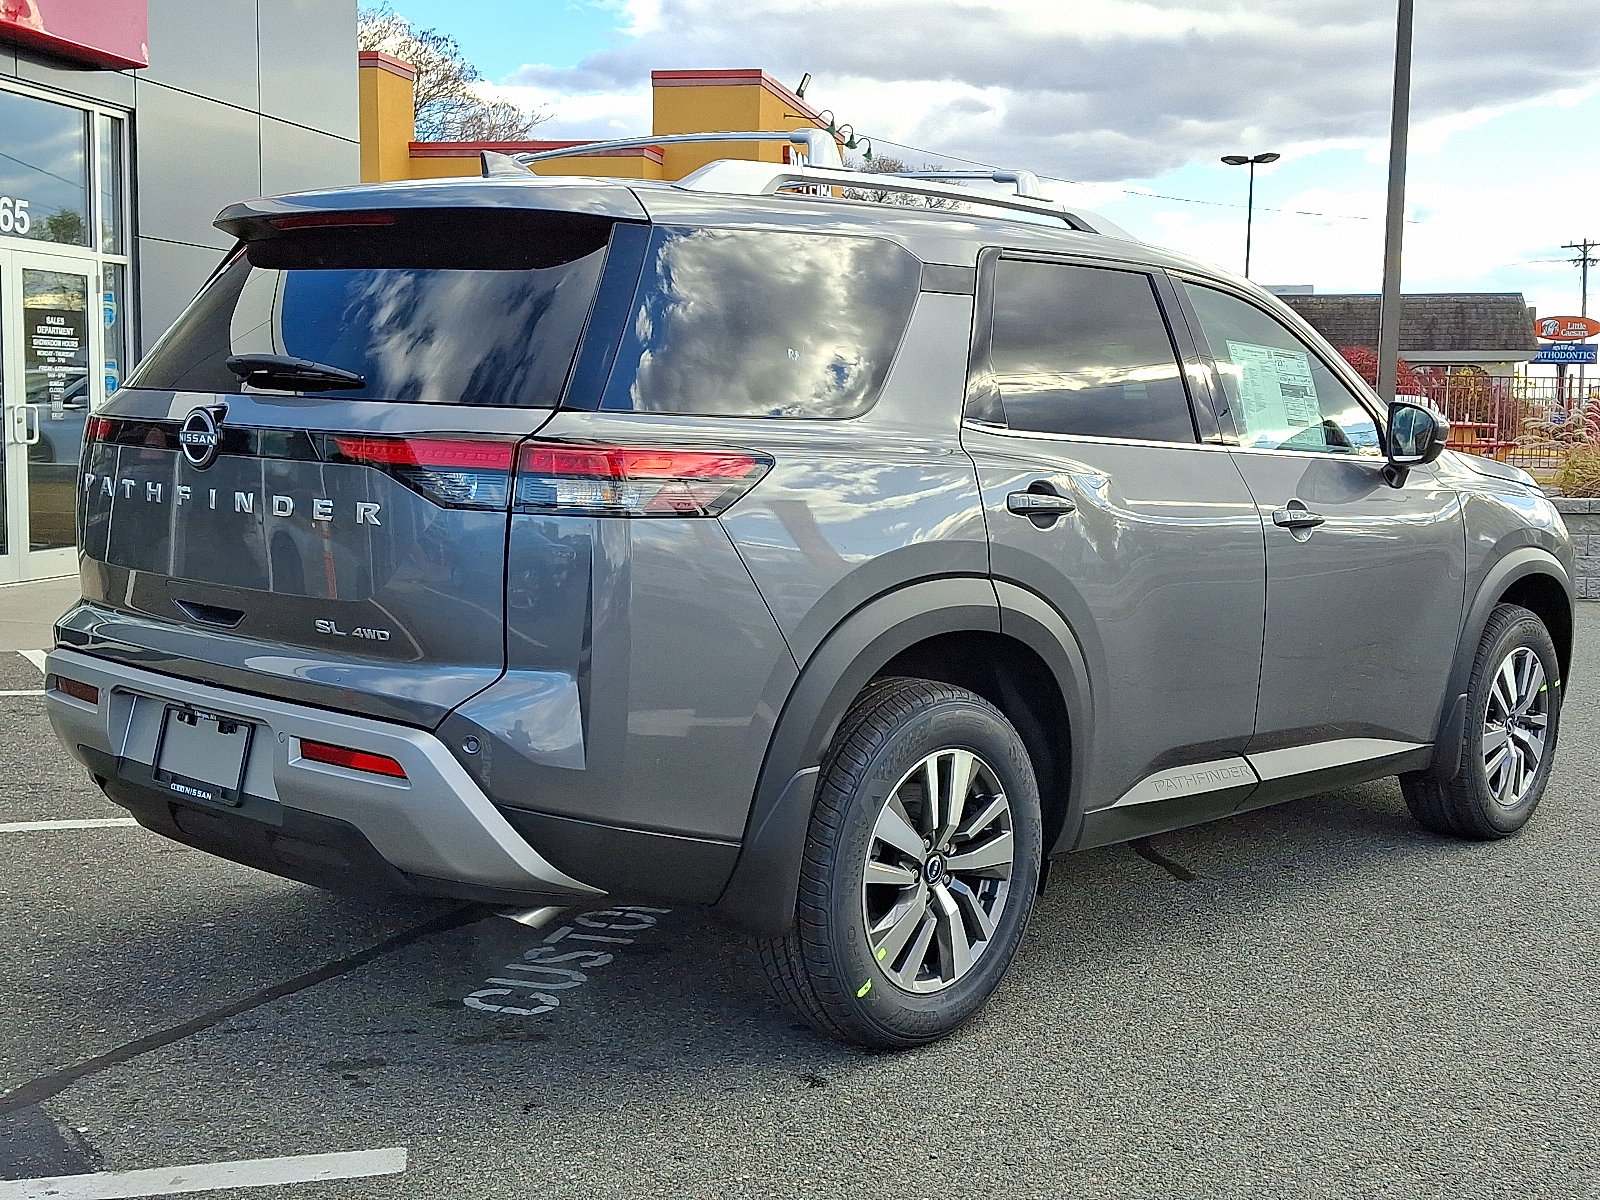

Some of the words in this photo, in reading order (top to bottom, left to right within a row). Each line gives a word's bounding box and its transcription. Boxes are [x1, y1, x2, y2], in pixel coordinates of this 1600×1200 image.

[45, 315, 65, 326] SALES
[1567, 322, 1587, 330] Little
[36, 325, 75, 336] DEPARTMENT
[1560, 329, 1589, 337] Caesars
[179, 432, 217, 446] NISSAN
[83, 472, 382, 527] PATHFINDER
[314, 618, 347, 638] SL
[351, 626, 392, 642] 4WD
[1150, 765, 1252, 793] PATHFINDER
[462, 905, 674, 1016] CUSTO
